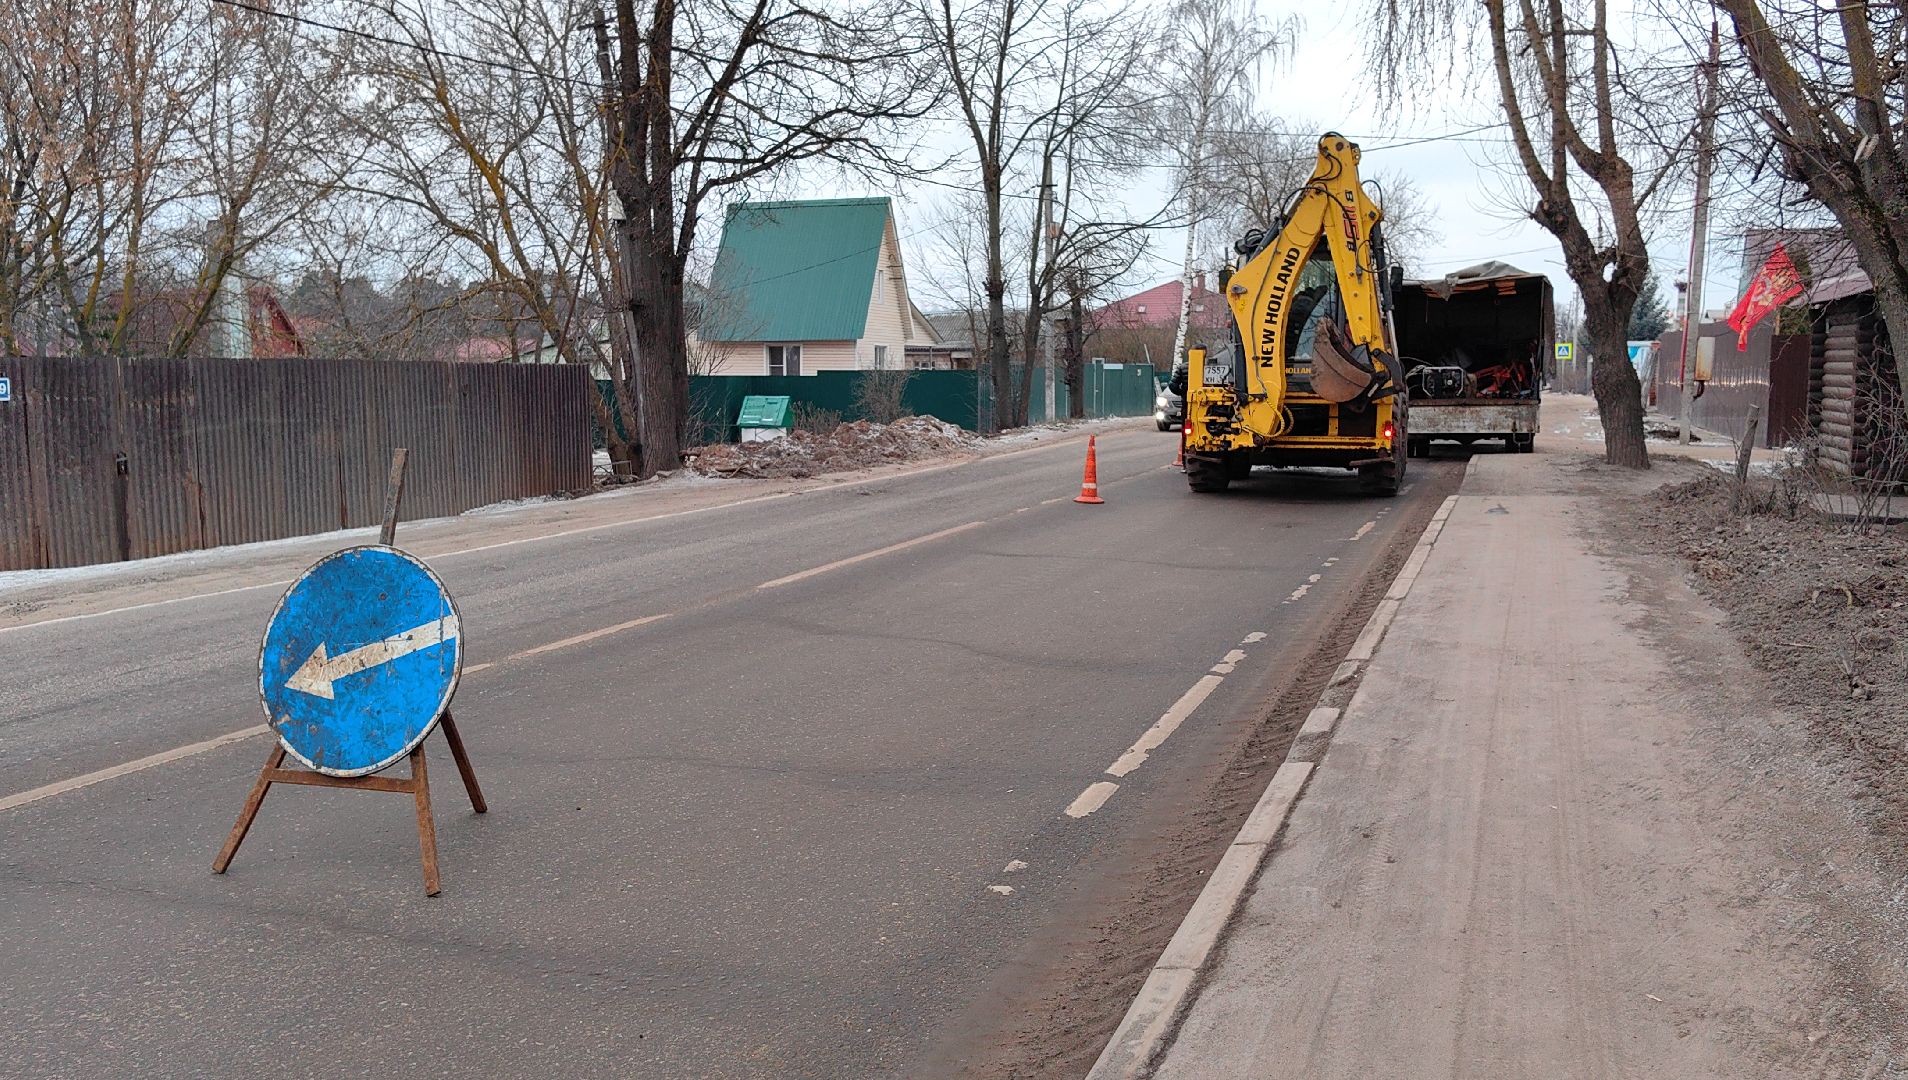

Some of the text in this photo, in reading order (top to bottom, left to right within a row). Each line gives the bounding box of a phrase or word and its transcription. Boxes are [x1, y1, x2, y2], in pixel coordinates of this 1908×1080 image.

[1261, 247, 1301, 368] NEW HOLLAND
[1205, 366, 1226, 375] 7557
